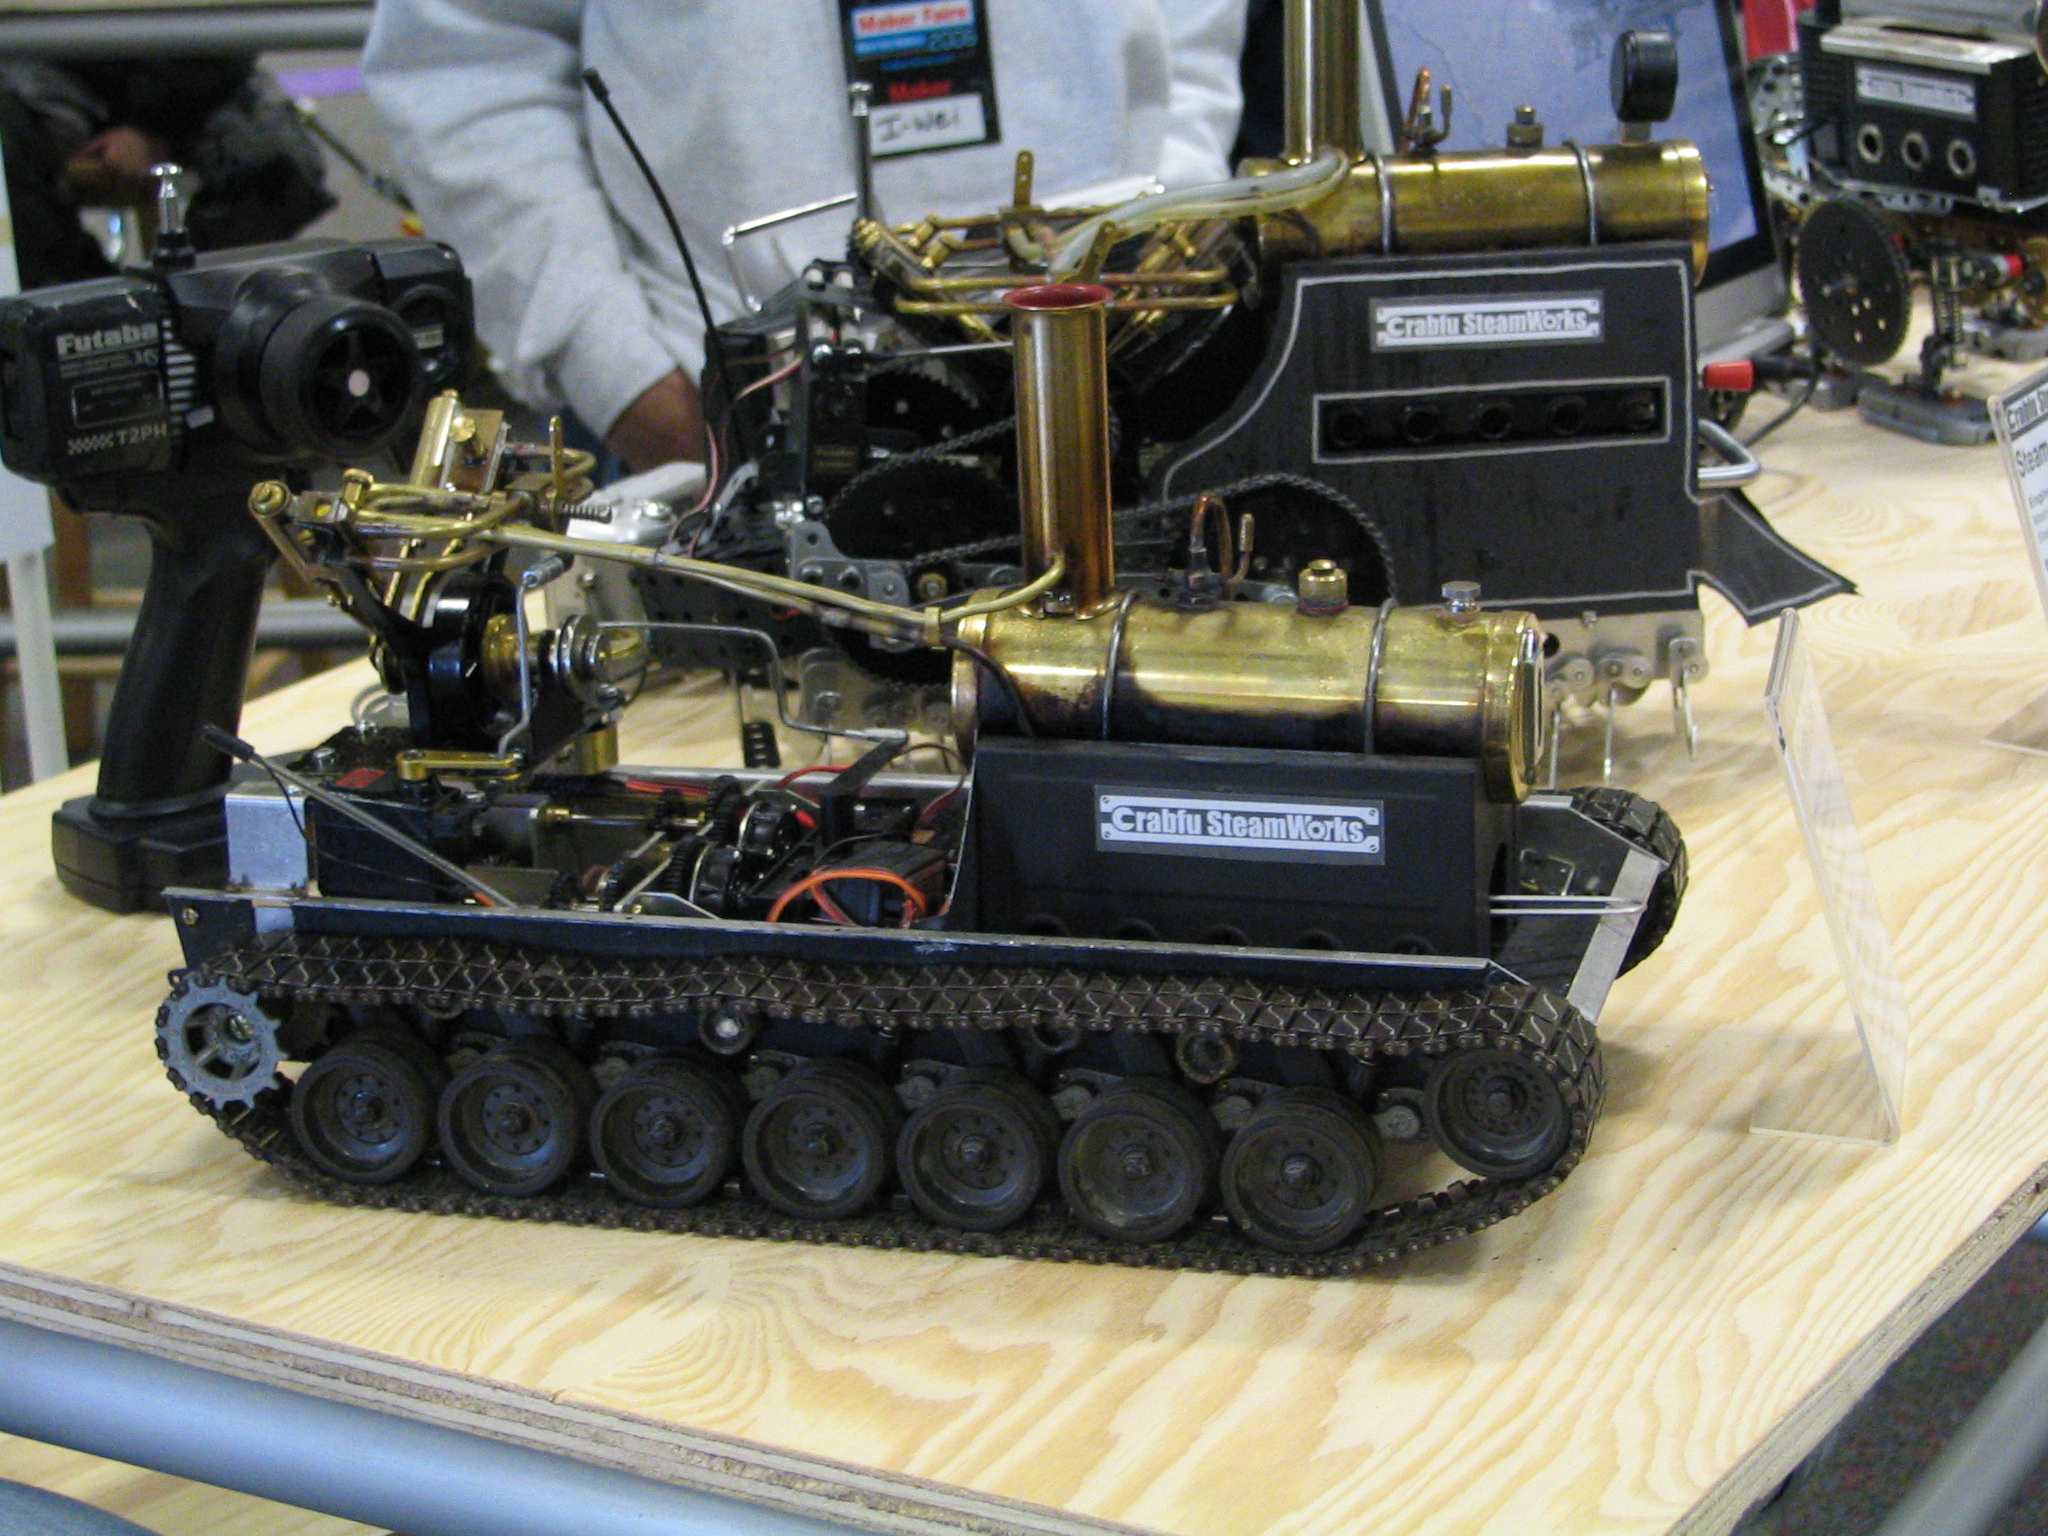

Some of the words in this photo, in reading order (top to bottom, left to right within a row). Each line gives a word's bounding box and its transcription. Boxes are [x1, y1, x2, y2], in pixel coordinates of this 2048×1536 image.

[858, 14, 917, 32] Maker
[1385, 314, 1460, 338] Crabfu
[1462, 309, 1588, 335] SteamWorks
[56, 323, 159, 356] Futaba
[1111, 805, 1202, 835] Crabfu
[1206, 809, 1364, 843] SteamWorks
